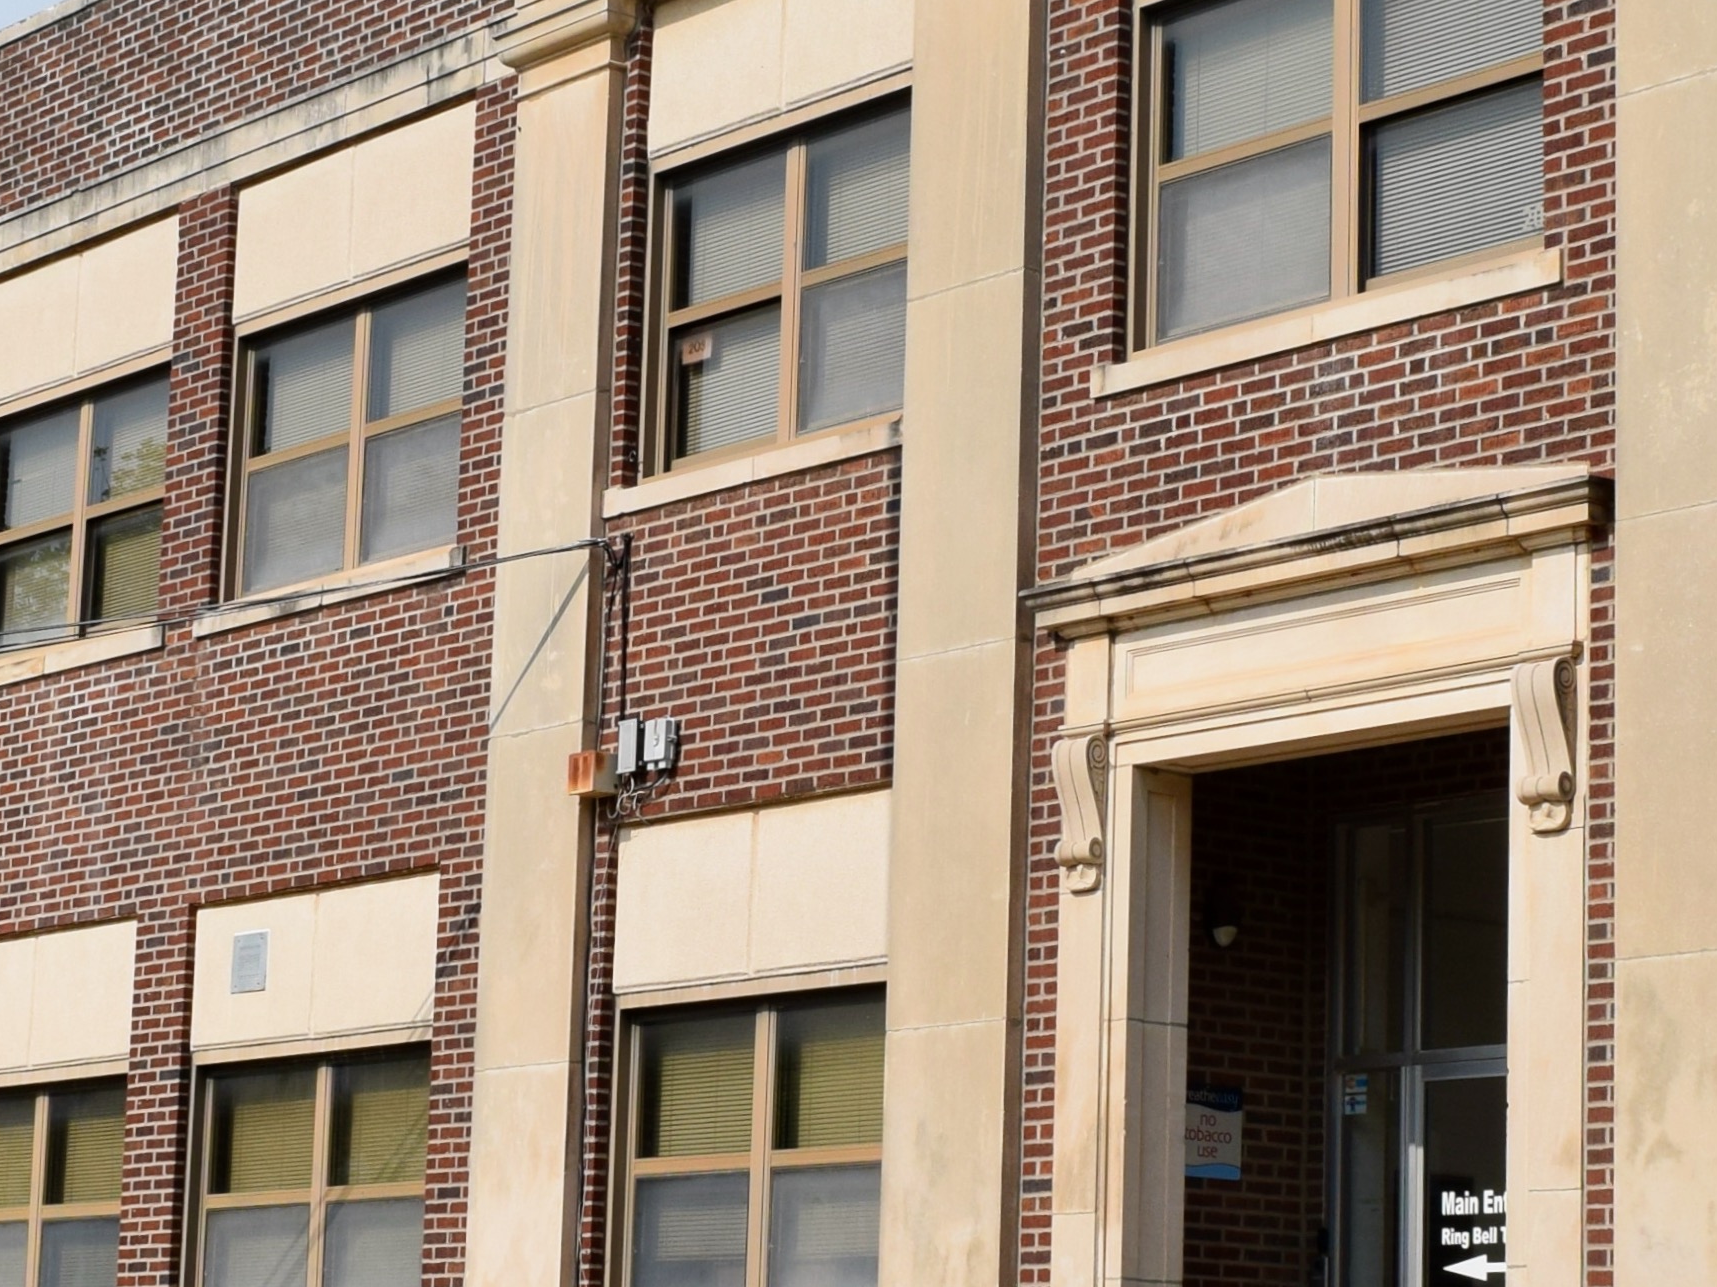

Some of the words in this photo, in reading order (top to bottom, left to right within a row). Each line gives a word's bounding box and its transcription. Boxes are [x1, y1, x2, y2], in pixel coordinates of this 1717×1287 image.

[1199, 1114, 1218, 1127] no
[1185, 1125, 1233, 1144] tobacco
[1197, 1144, 1218, 1158] use
[1441, 1190, 1480, 1216] Main
[1441, 1227, 1470, 1249] Ring
[1472, 1226, 1498, 1245] Bell
